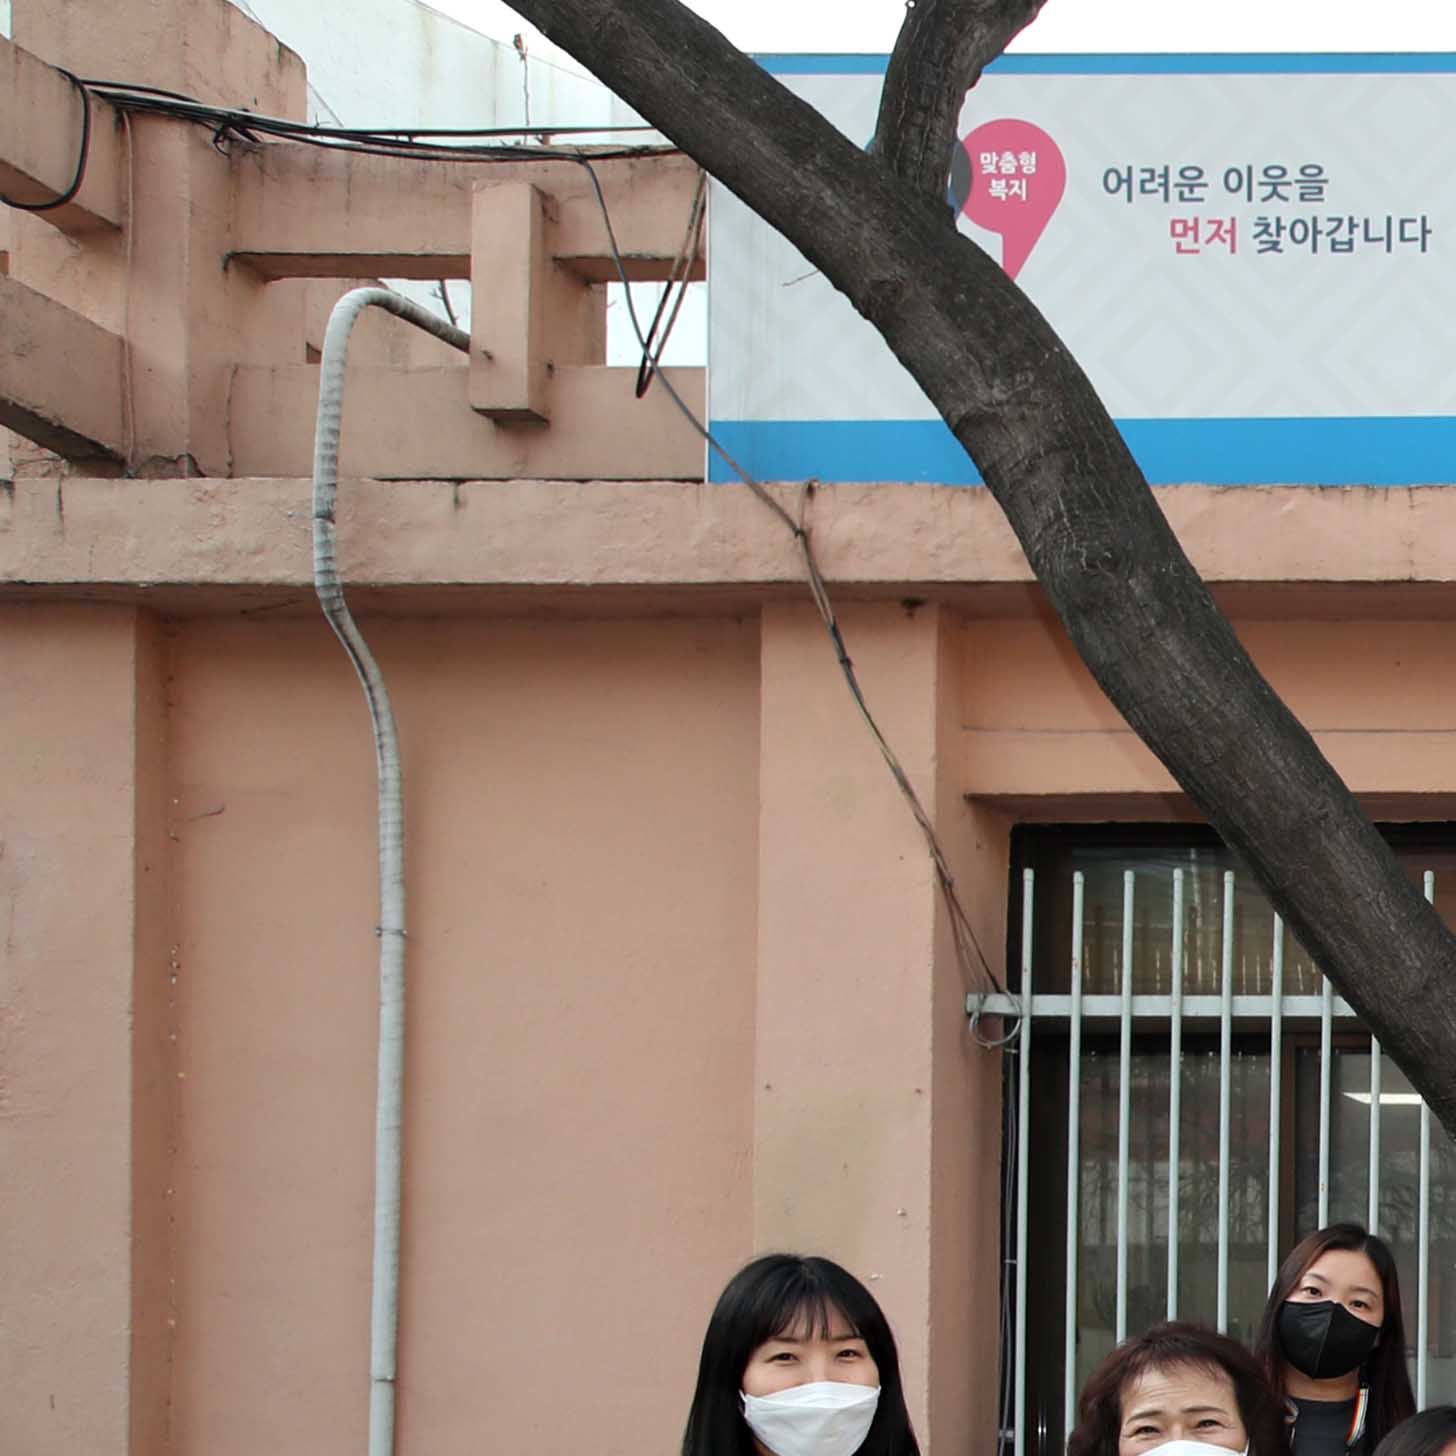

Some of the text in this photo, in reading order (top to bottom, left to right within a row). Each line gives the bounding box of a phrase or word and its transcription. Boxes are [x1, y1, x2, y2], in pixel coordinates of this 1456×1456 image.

[980, 151, 1036, 174] 맞춤형
[988, 178, 1026, 201] 복지
[1102, 163, 1329, 204] 어려운 이웃을
[1170, 215, 1433, 255] 먼저 찾아갑니다
